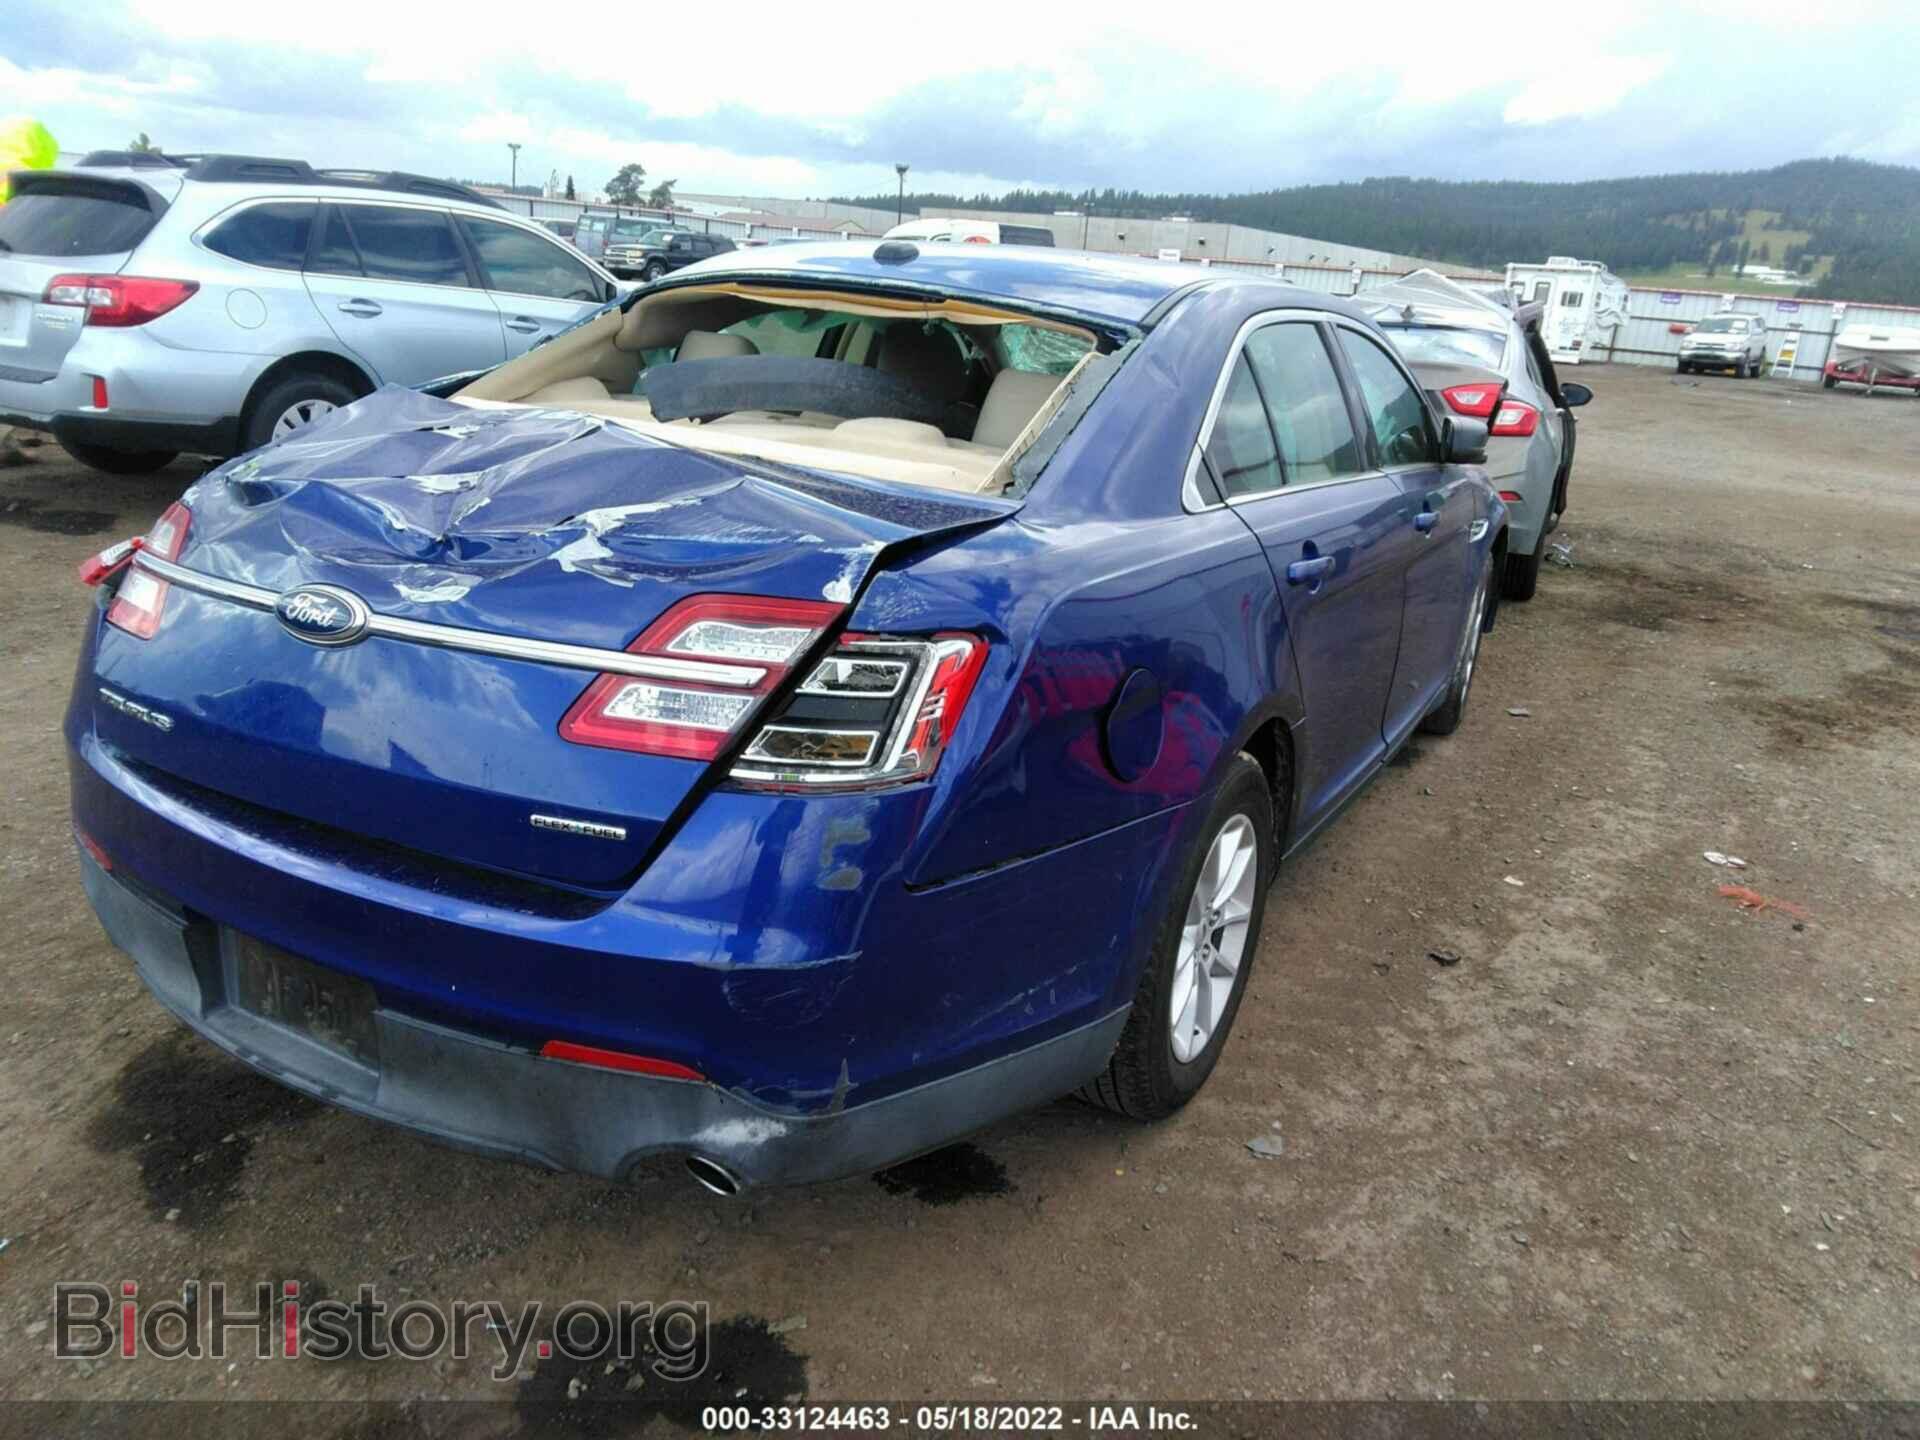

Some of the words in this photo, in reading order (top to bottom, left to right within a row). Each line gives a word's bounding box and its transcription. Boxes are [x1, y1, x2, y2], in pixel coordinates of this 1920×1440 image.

[286, 592, 338, 627] Ford
[533, 817, 570, 832] FLEX
[582, 825, 623, 840] FUEL
